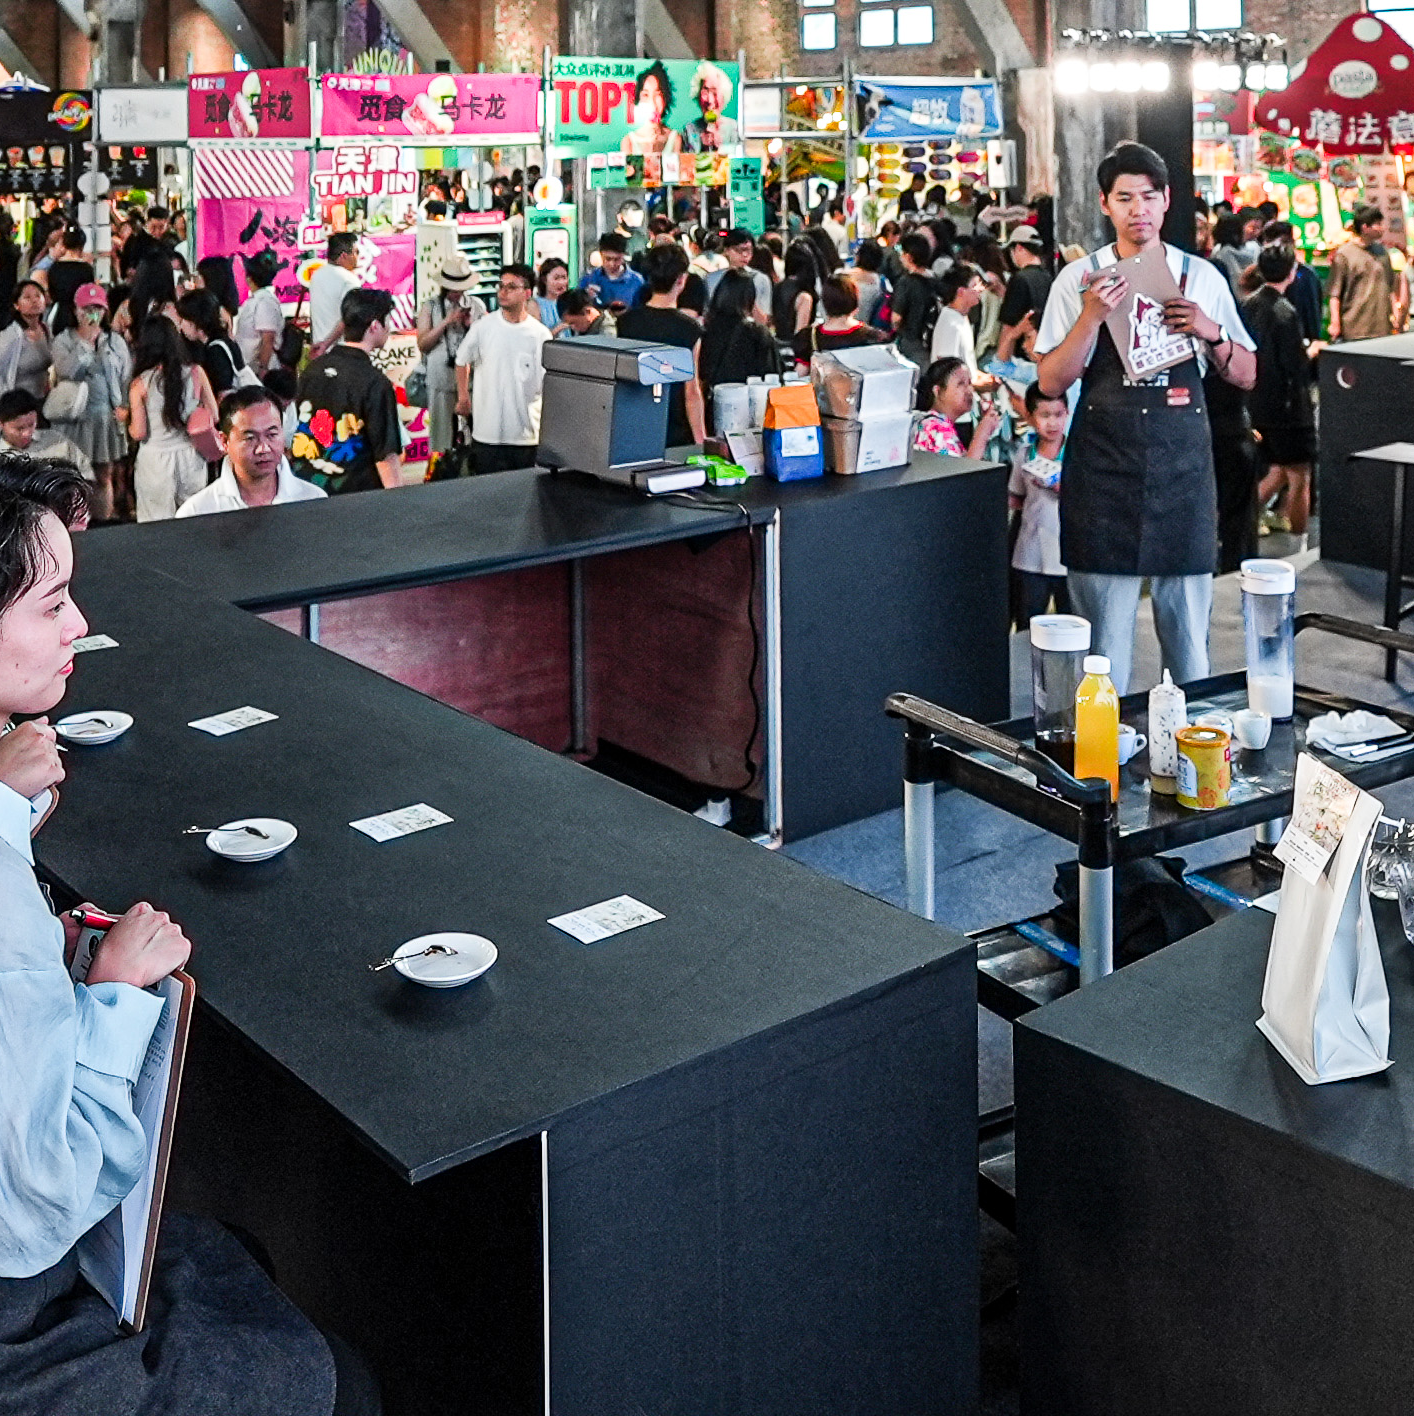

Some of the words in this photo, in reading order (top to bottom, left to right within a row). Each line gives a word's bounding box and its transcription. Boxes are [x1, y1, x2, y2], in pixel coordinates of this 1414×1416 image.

[439, 93, 506, 122] 马卡龙
[337, 146, 399, 174] 天津
[315, 173, 374, 196] TIAN
[379, 172, 415, 196] JIN
